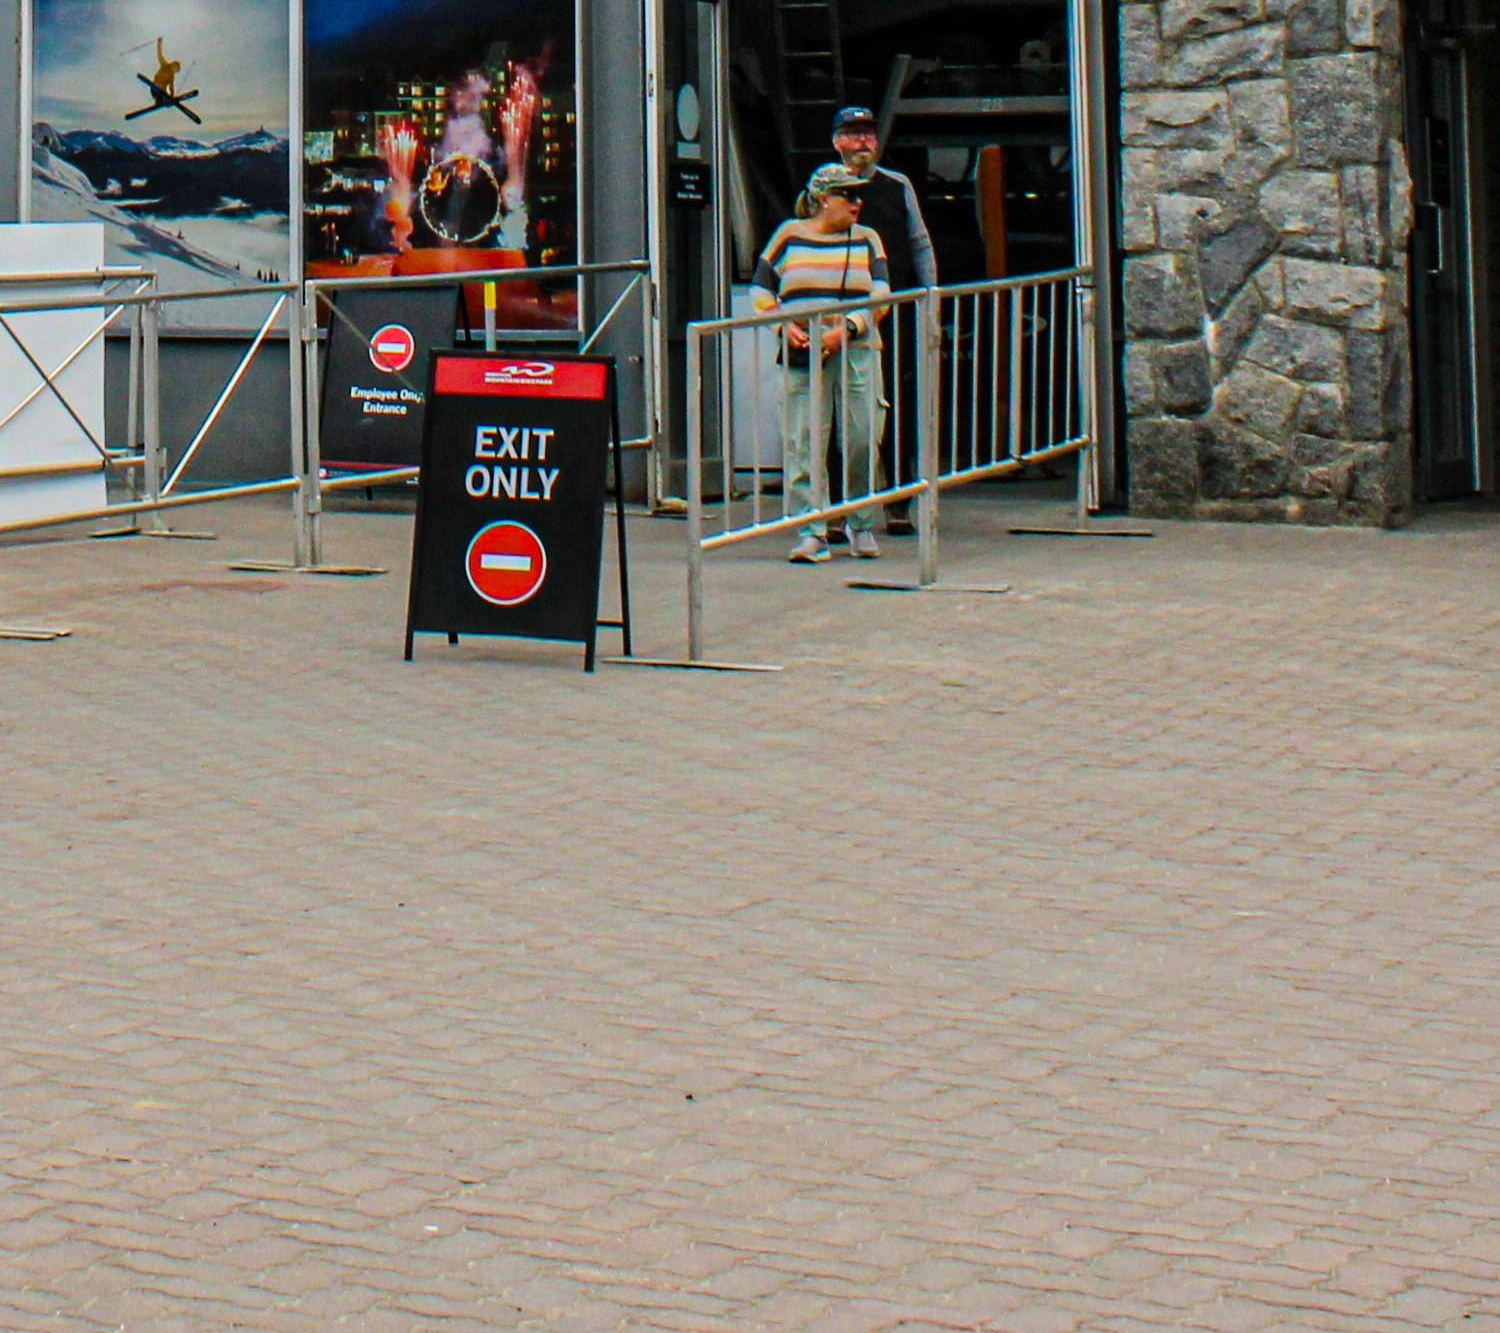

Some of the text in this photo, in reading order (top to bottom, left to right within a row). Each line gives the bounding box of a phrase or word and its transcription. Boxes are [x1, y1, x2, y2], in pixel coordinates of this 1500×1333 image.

[350, 386, 398, 402] Employee
[362, 401, 408, 416] Entrance
[474, 425, 556, 461] EXIT
[464, 463, 560, 501] ONLY
